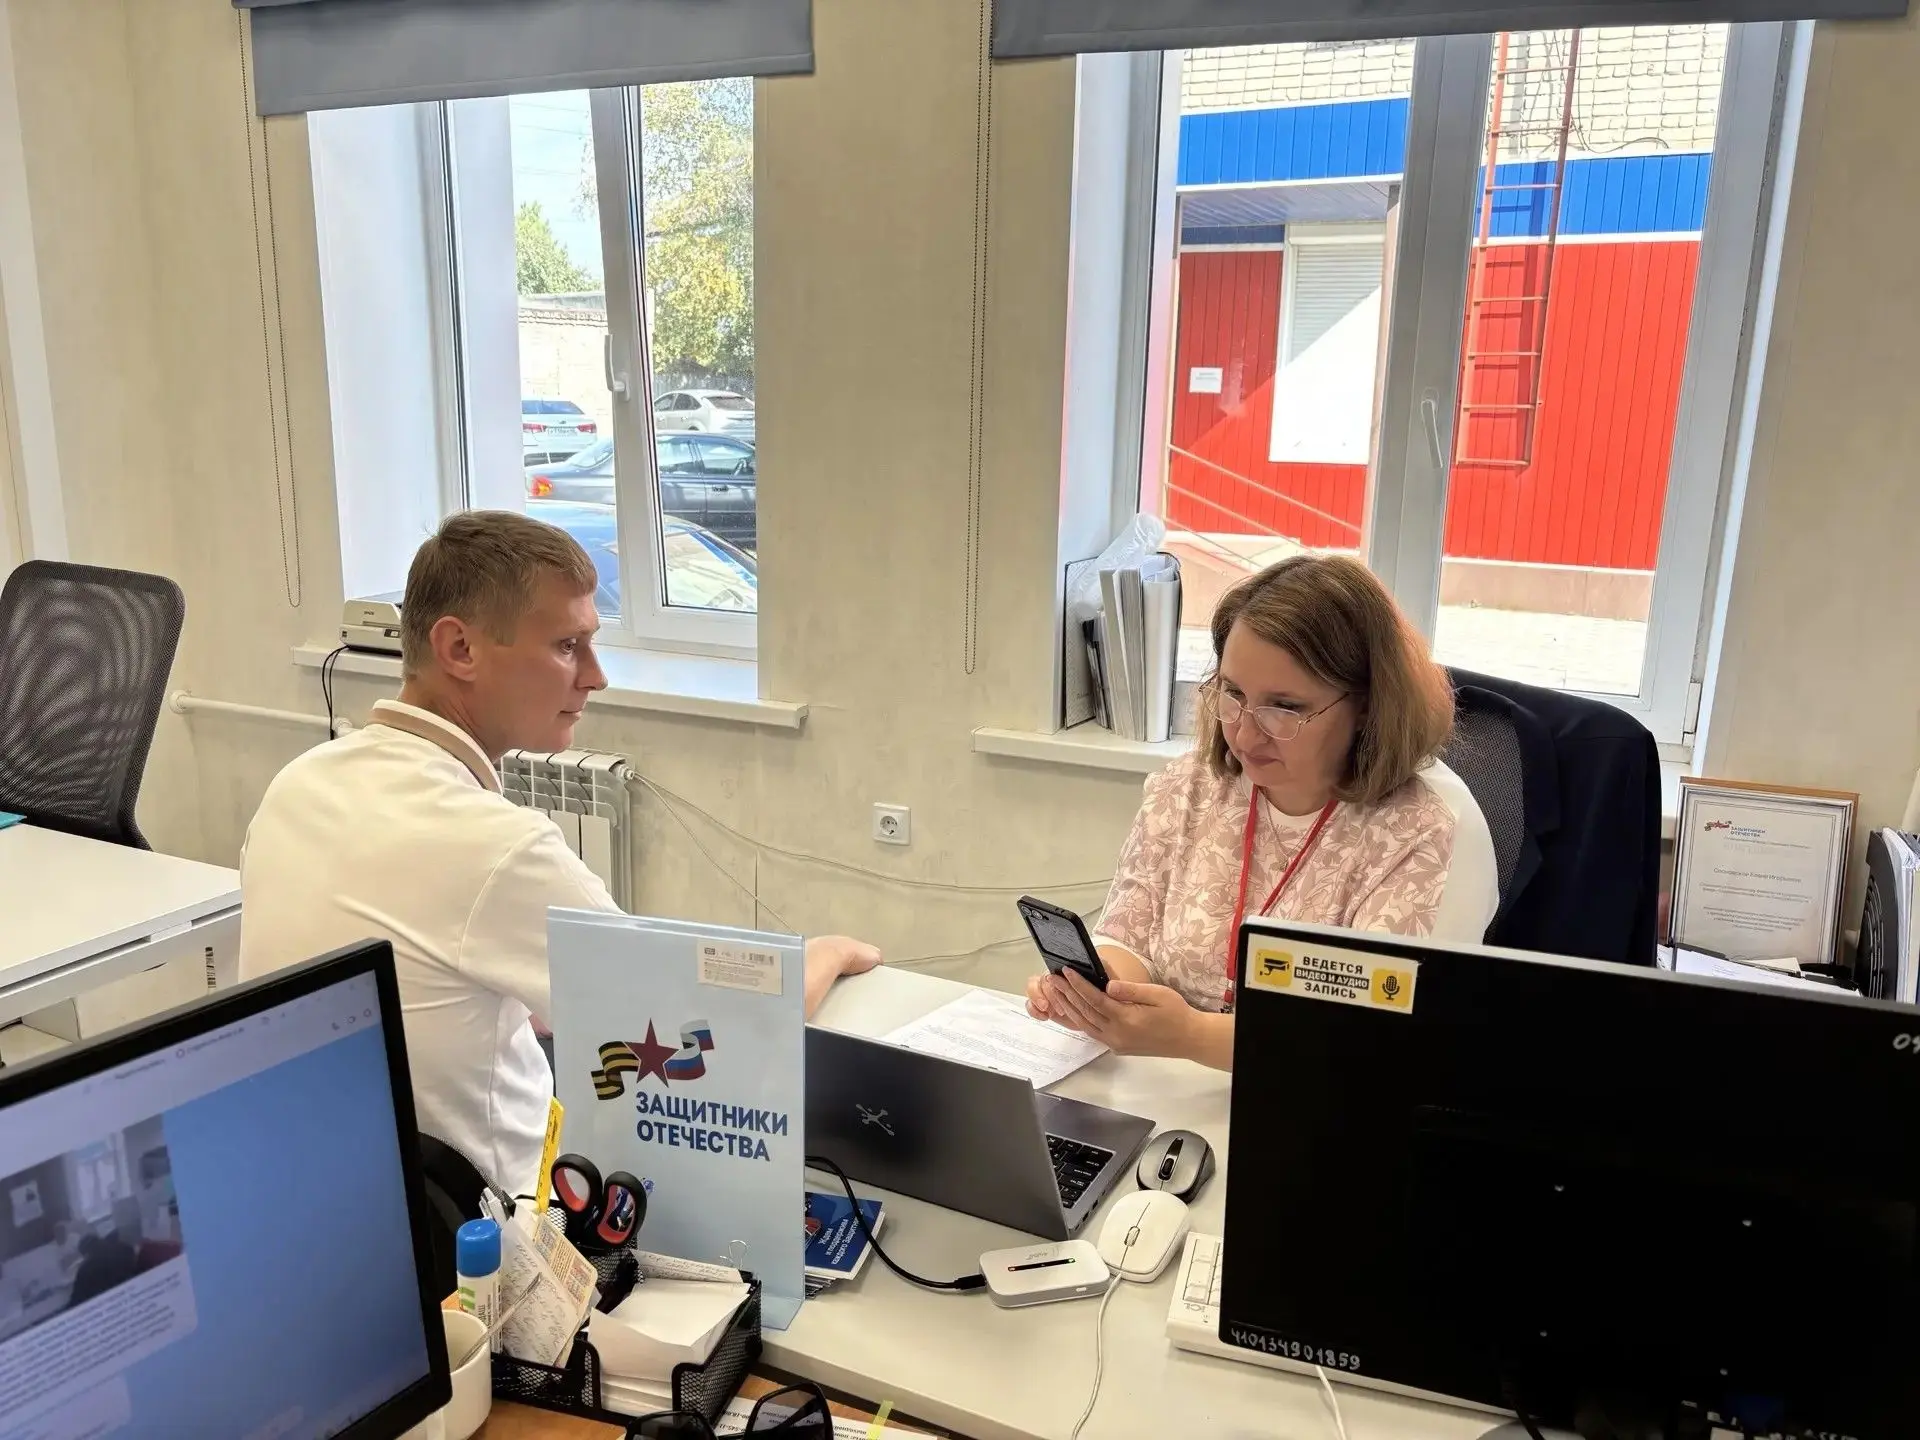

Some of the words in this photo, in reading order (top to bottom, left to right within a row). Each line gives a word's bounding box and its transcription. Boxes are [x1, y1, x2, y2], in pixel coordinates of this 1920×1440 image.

[1302, 956, 1363, 975] ВЕДЕТСЯ
[1295, 968, 1327, 983] ВИДЕО
[1328, 974, 1335, 983] И
[1336, 976, 1368, 989] АУДИО
[1304, 982, 1357, 999] ЗАПИСЬ
[636, 1091, 788, 1136] ЗАЩИТНИКИ
[636, 1119, 770, 1162] ОТЕЧЕСТВА
